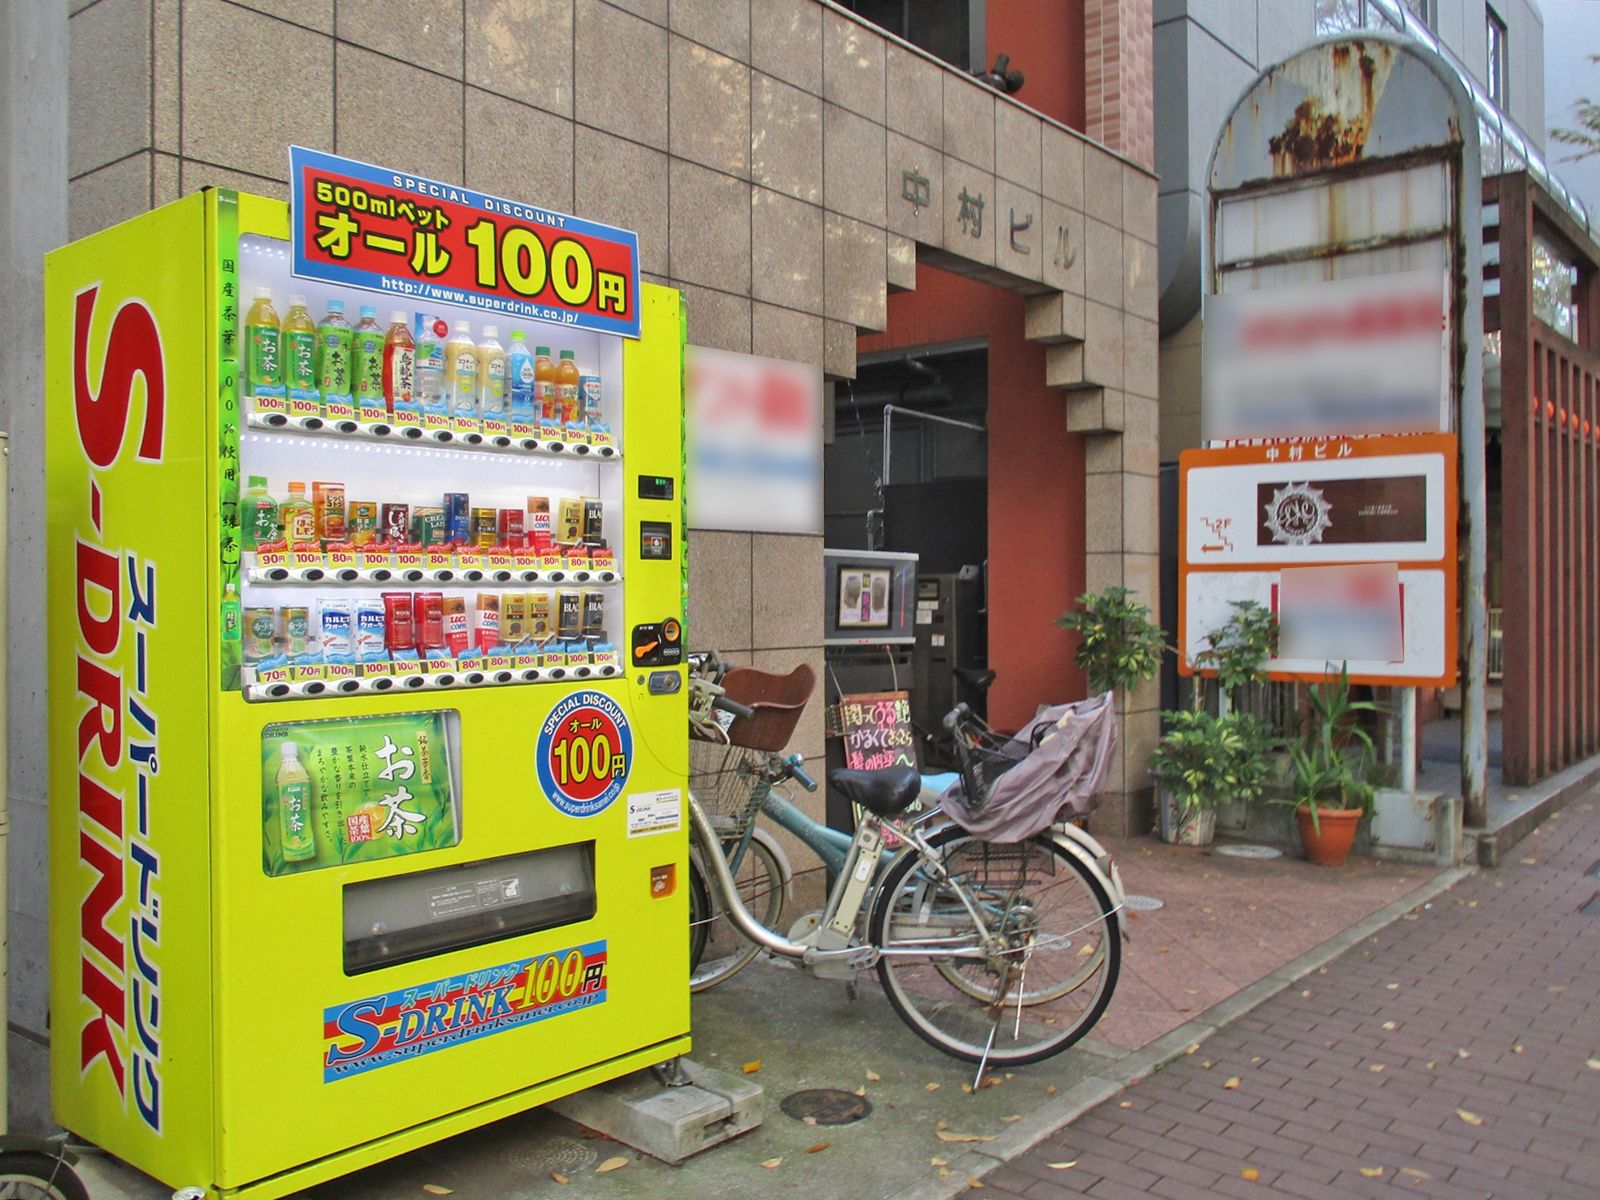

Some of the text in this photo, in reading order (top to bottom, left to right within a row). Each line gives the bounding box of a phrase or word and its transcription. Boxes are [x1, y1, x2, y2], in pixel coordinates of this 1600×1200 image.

[315, 181, 451, 231] 500mlペット
[392, 174, 578, 228] SPECIAL DISCOUNT
[901, 165, 1077, 271] 中村ビル
[316, 212, 628, 320] オール 100円
[380, 276, 592, 328] http://www.superdrink.co.jp/
[1265, 441, 1353, 464] 中村ビル
[74, 284, 165, 1104] S-DRINK
[543, 693, 627, 736] SPECIAL DISCOUNT
[568, 717, 603, 734] オール
[552, 733, 628, 786] 100円
[373, 734, 426, 841] お茶
[129, 553, 161, 1137] スーパードリンク
[325, 983, 516, 1067] S-DRINK
